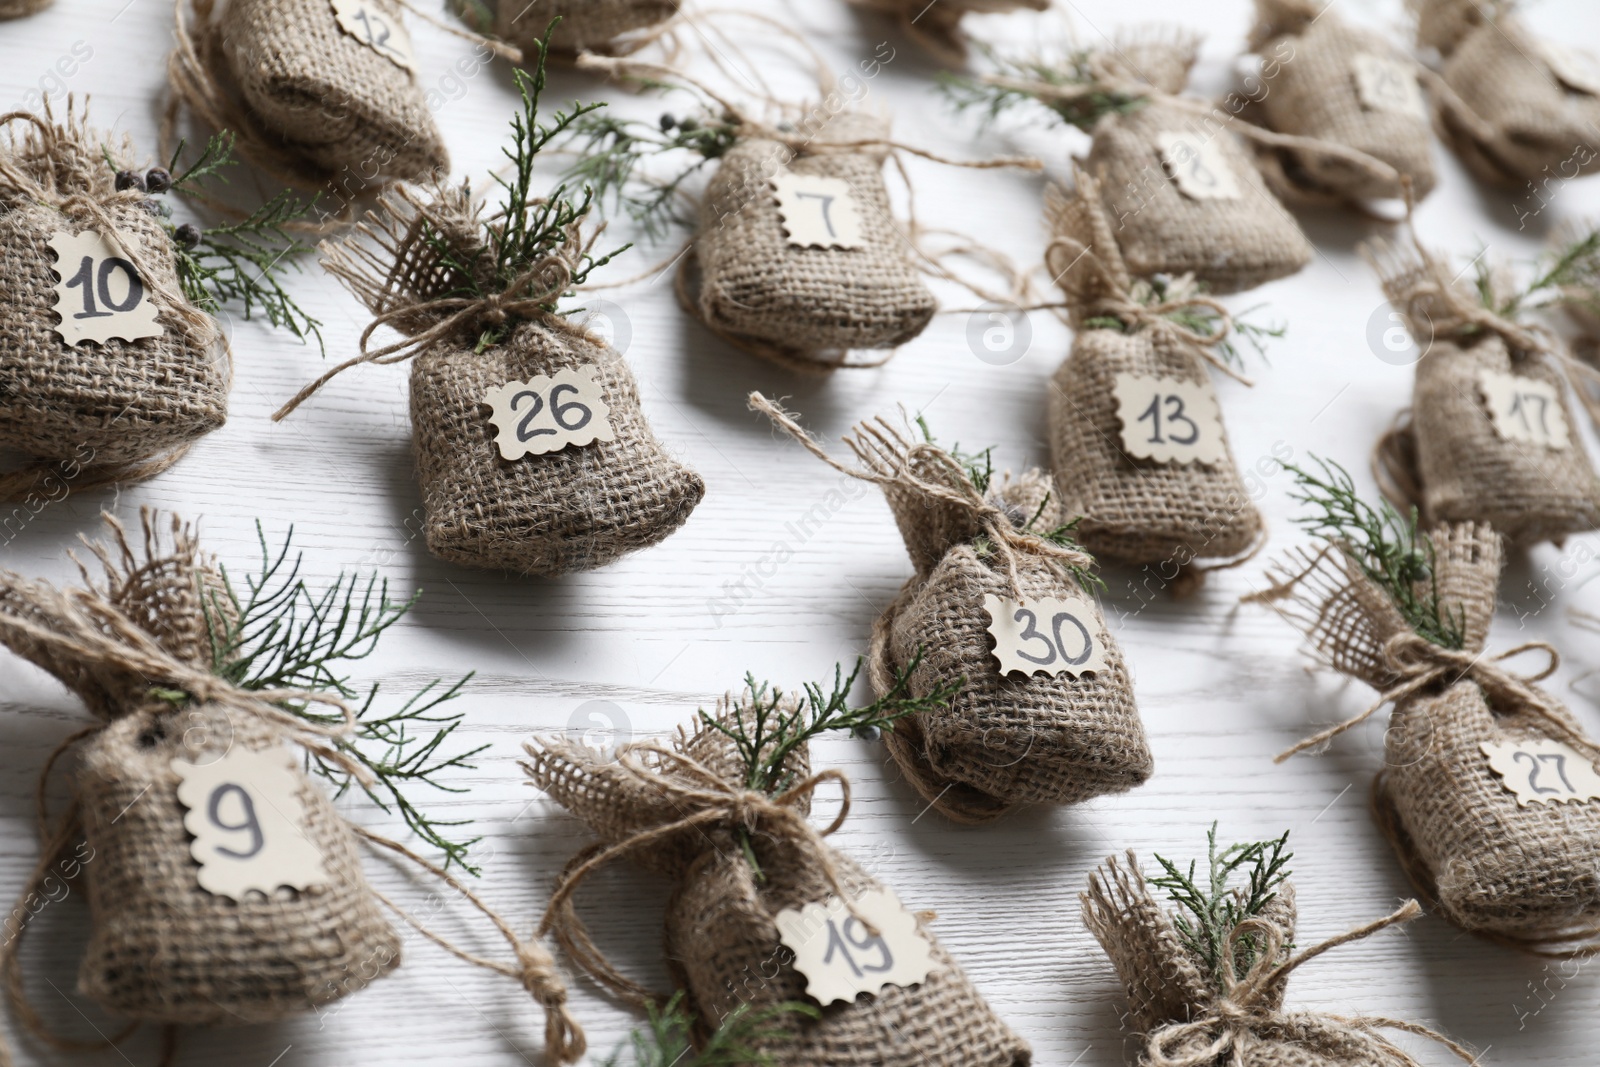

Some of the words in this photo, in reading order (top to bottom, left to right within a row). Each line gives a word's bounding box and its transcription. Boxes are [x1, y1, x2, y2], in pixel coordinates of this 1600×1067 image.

[351, 7, 407, 59] 12
[795, 191, 838, 238] 7
[65, 256, 144, 320] 10
[510, 383, 593, 443] 26
[1136, 393, 1200, 446] 13
[1508, 391, 1550, 437] 17
[1013, 608, 1093, 666] 30
[1512, 751, 1577, 795] 27
[206, 781, 265, 860] 9
[822, 911, 895, 979] 19
